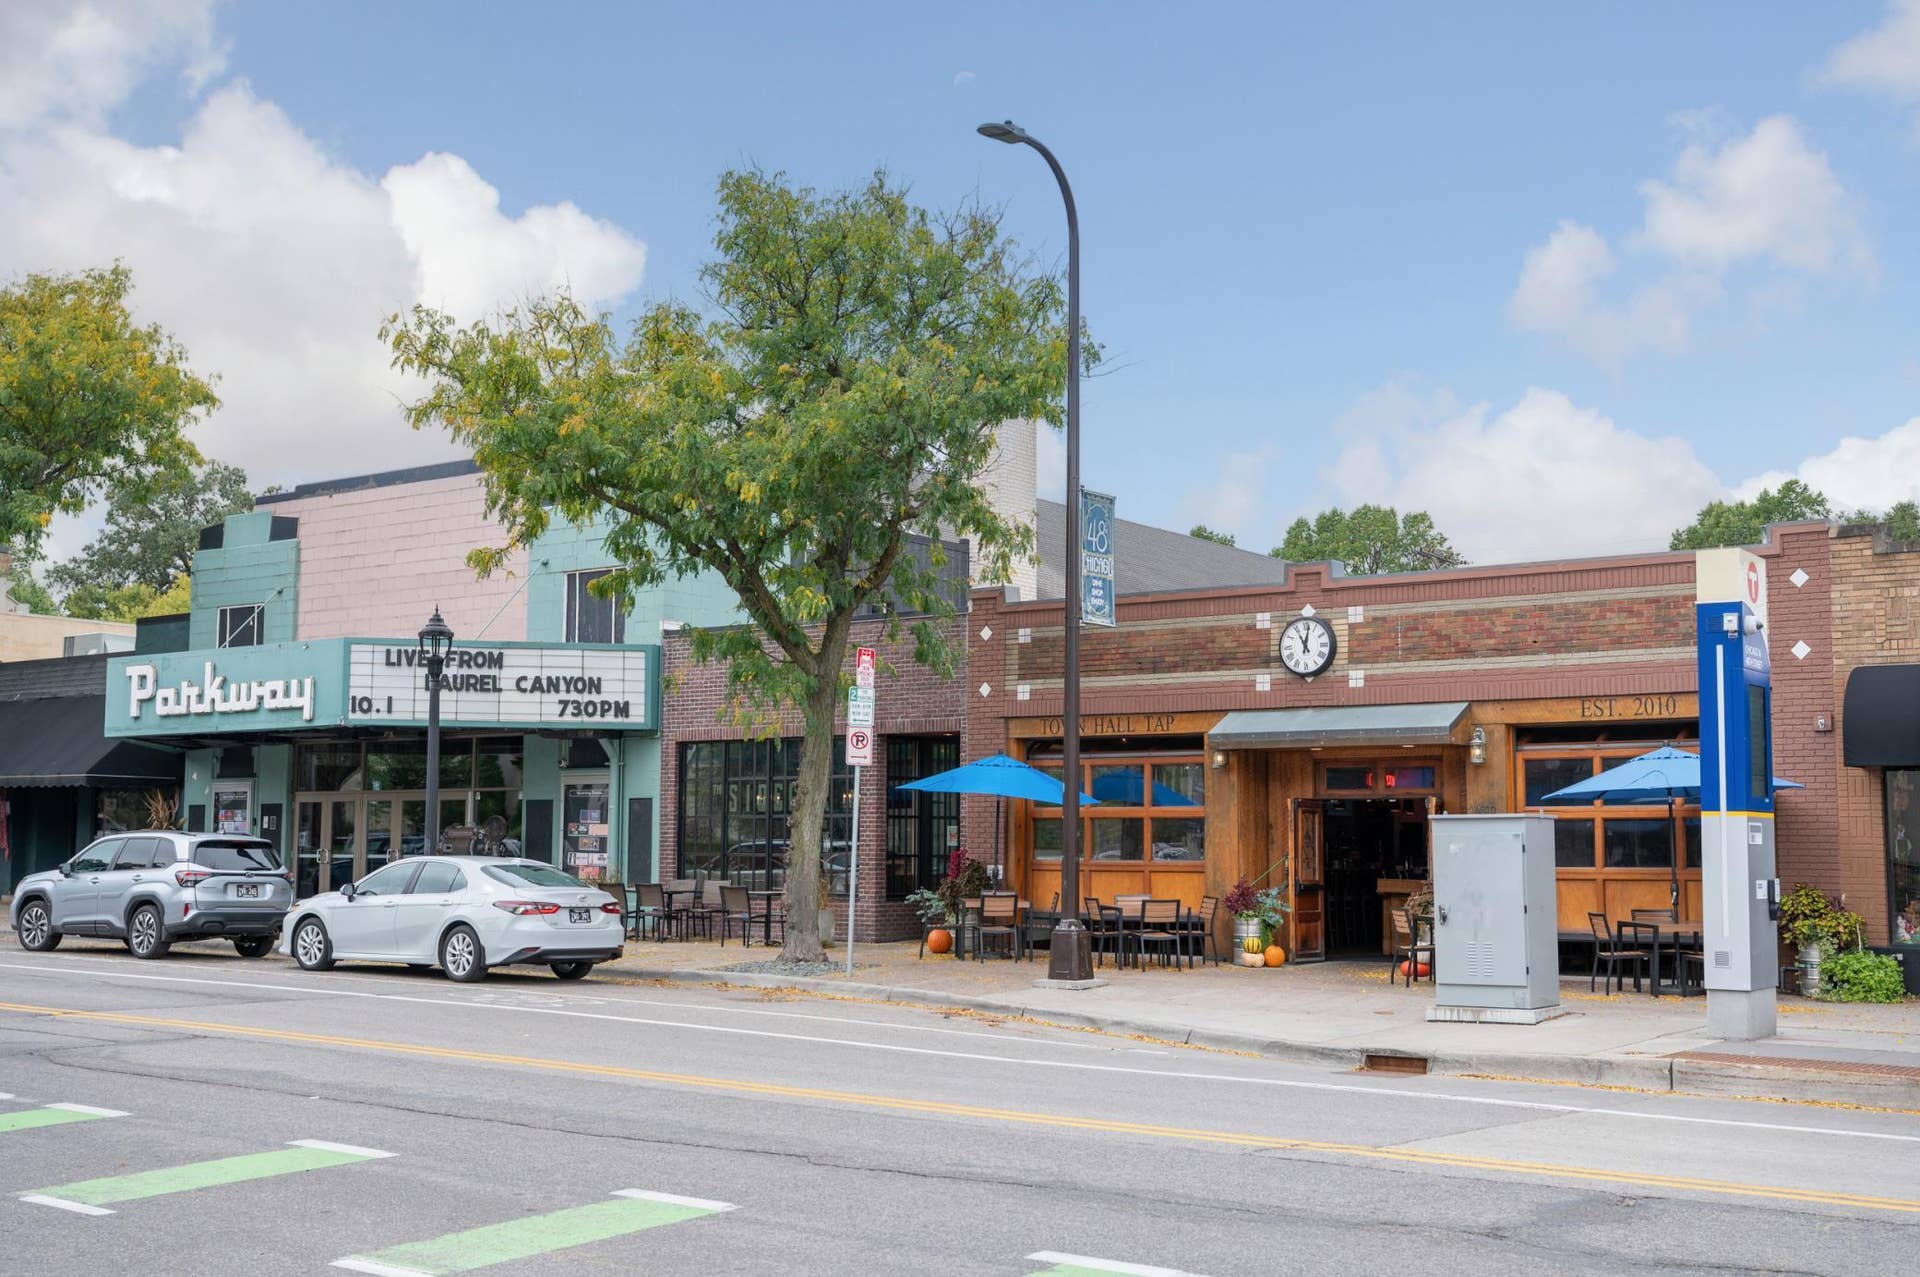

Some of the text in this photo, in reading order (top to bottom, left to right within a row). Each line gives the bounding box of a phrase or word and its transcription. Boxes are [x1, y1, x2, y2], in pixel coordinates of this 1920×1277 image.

[1087, 519, 1108, 553] 48
[385, 648, 504, 670] LIVE FROM
[124, 661, 315, 721] Parkway
[515, 675, 603, 695] CANYON
[557, 699, 630, 719] 730PM
[1581, 695, 1677, 718] EST. 2010
[1040, 715, 1174, 735] TON HALL TAP
